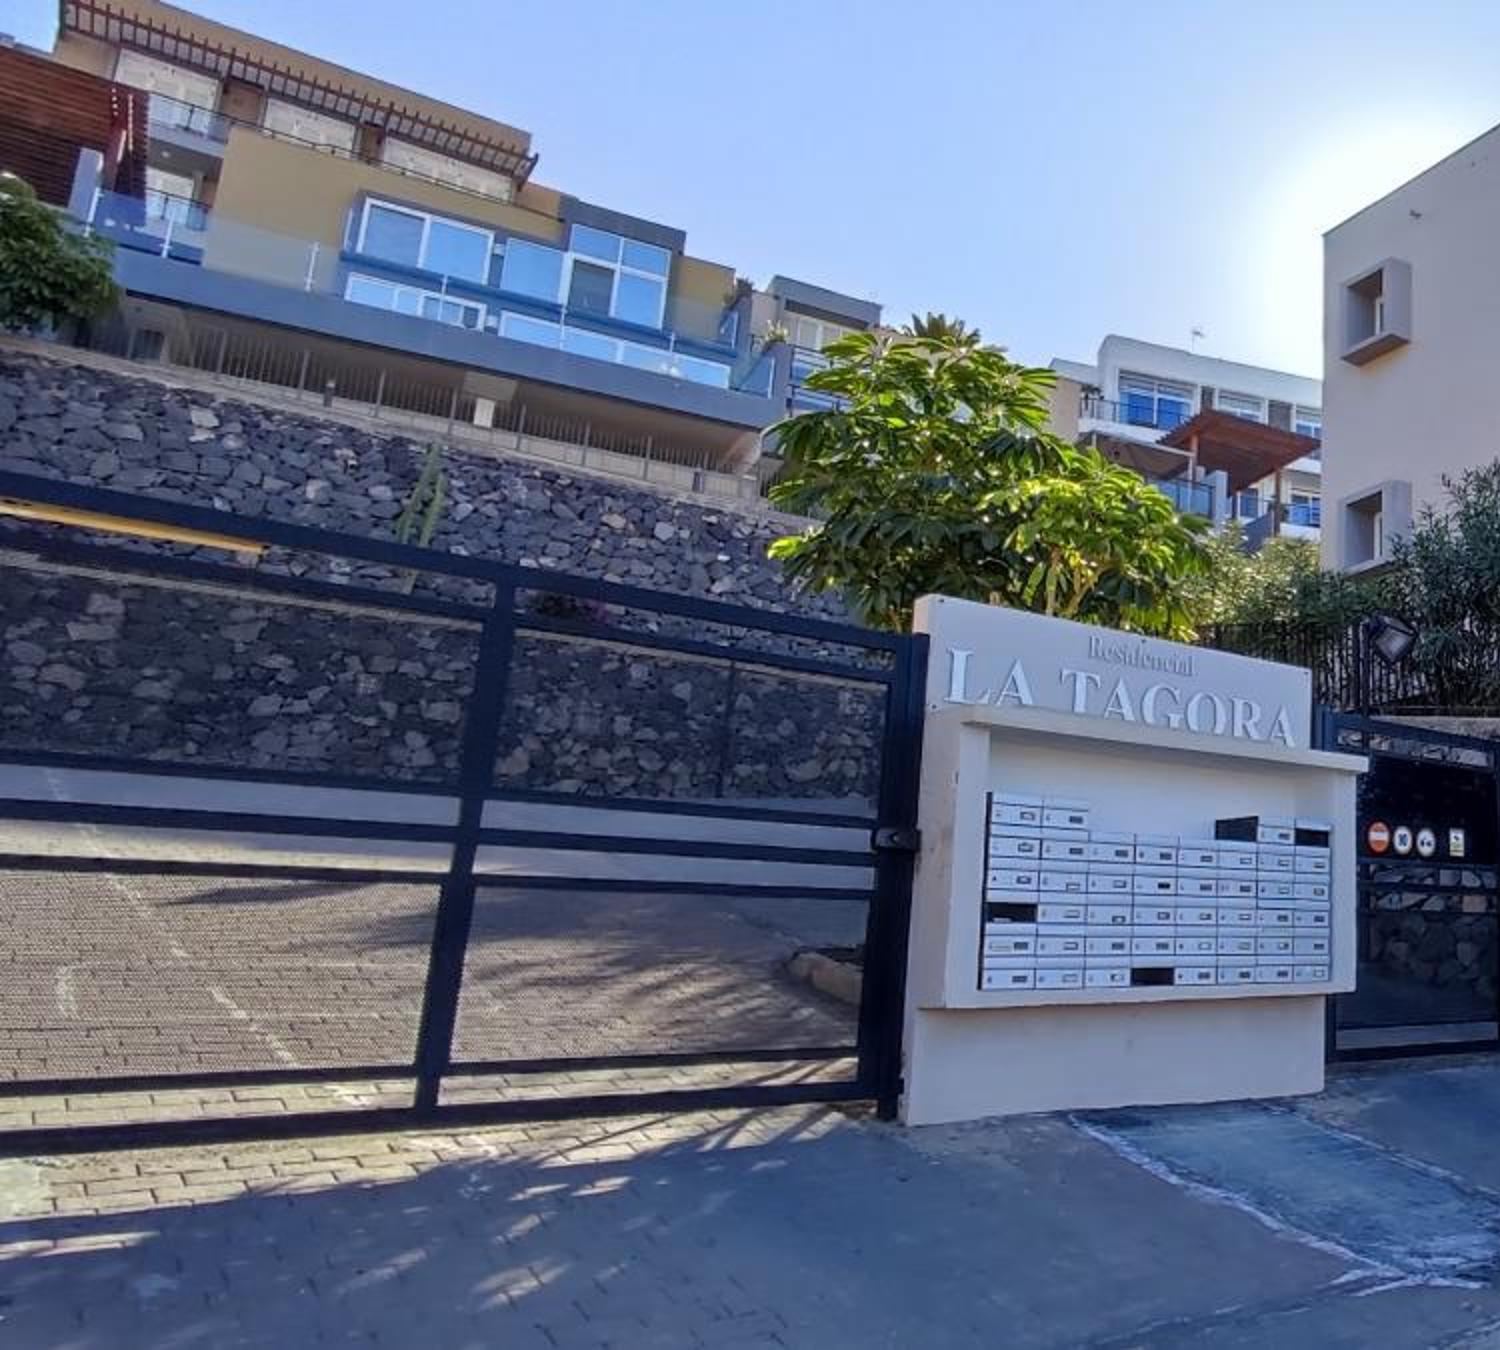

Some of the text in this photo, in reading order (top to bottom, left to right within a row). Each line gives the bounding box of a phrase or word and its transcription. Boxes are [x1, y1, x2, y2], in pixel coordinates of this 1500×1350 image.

[1089, 635, 1194, 677] Residencial
[944, 648, 1297, 748] LA TAGORA
